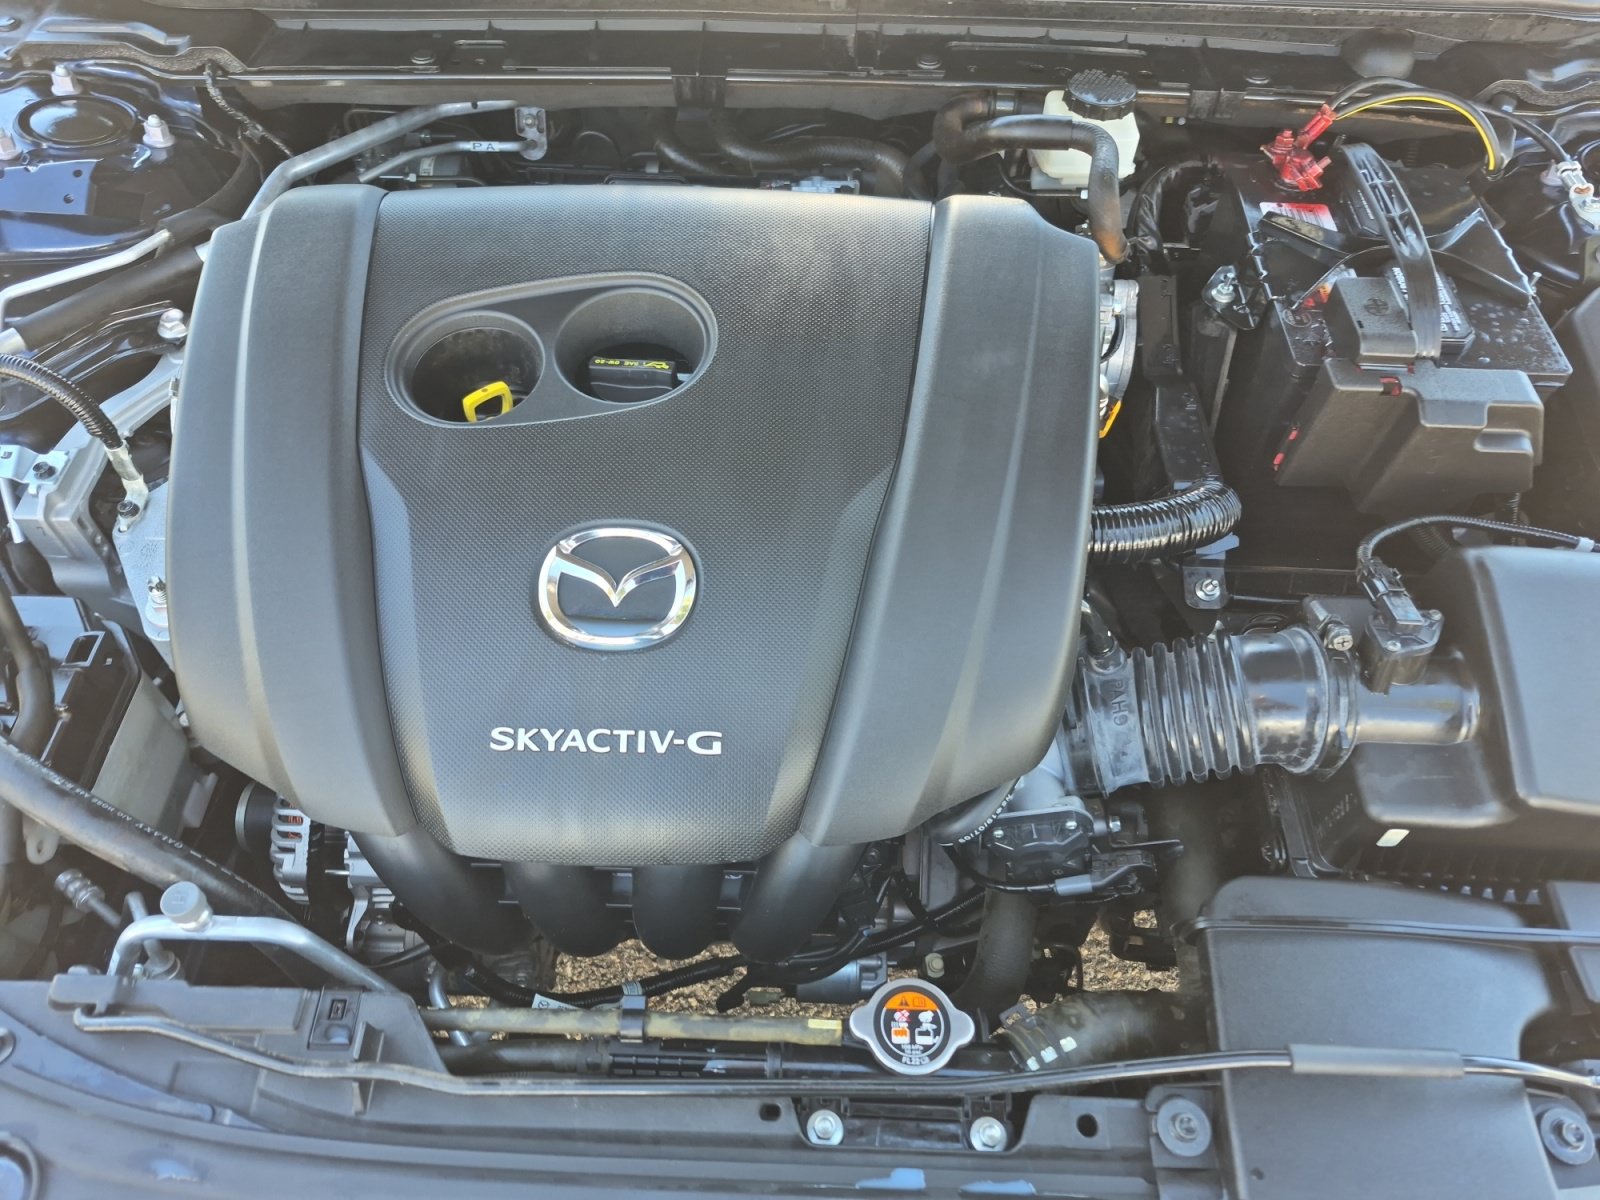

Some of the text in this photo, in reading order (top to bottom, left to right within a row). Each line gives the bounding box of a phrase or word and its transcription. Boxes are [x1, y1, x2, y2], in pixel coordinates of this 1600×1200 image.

[594, 358, 621, 366] 0W-20
[489, 726, 723, 755] SKYACTIV-G
[136, 822, 185, 849] GALAXY
